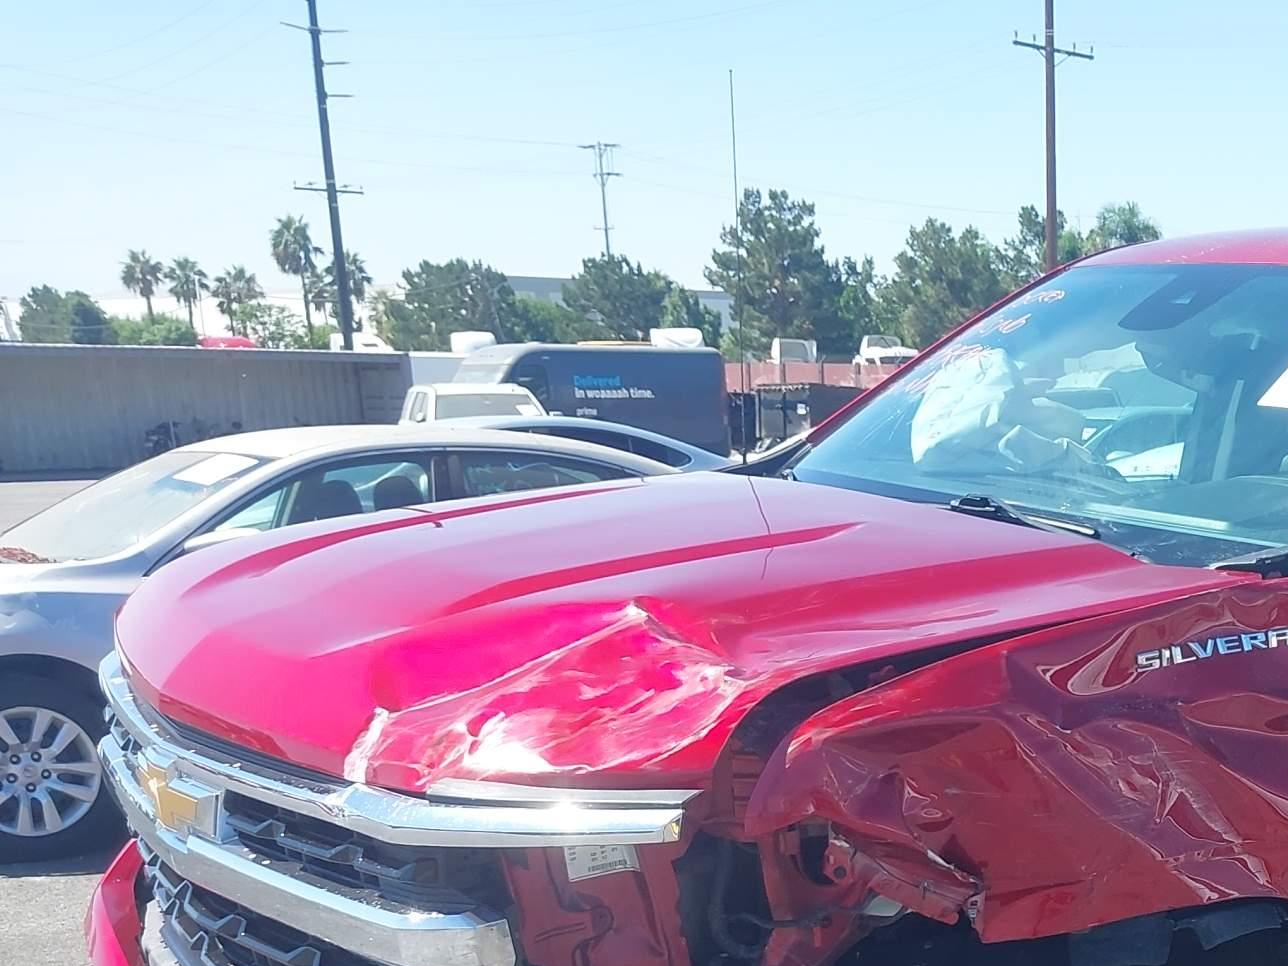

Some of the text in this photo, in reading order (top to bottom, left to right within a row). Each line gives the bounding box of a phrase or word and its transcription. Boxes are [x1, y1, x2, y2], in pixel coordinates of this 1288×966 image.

[573, 375, 621, 386] Delivered
[629, 387, 656, 399] time.
[575, 406, 598, 416] prime
